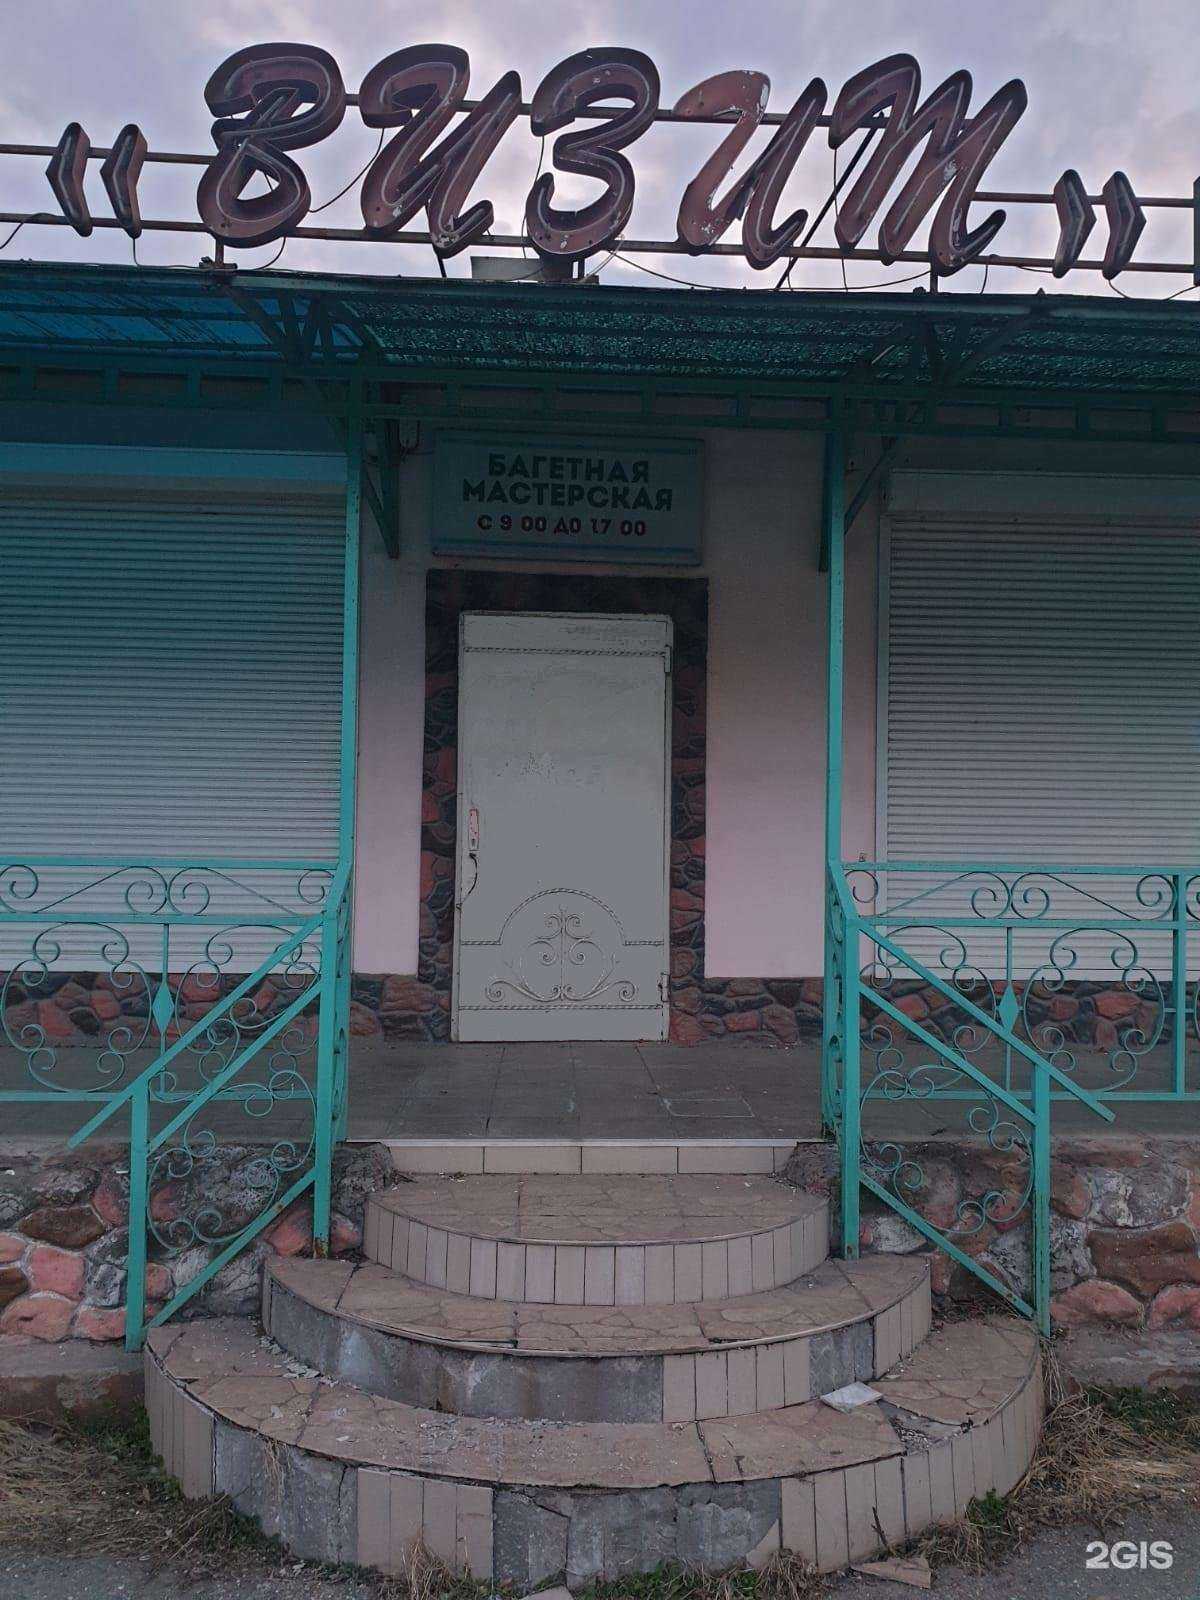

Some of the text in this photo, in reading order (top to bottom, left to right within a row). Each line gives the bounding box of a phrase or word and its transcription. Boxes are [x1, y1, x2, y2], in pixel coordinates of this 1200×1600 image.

[488, 453, 649, 483] БАГЕТНАЯ
[462, 478, 673, 512] МАСТЕРСКАЯ
[477, 514, 492, 531] С
[553, 516, 582, 535] ДО
[590, 518, 612, 535] 17
